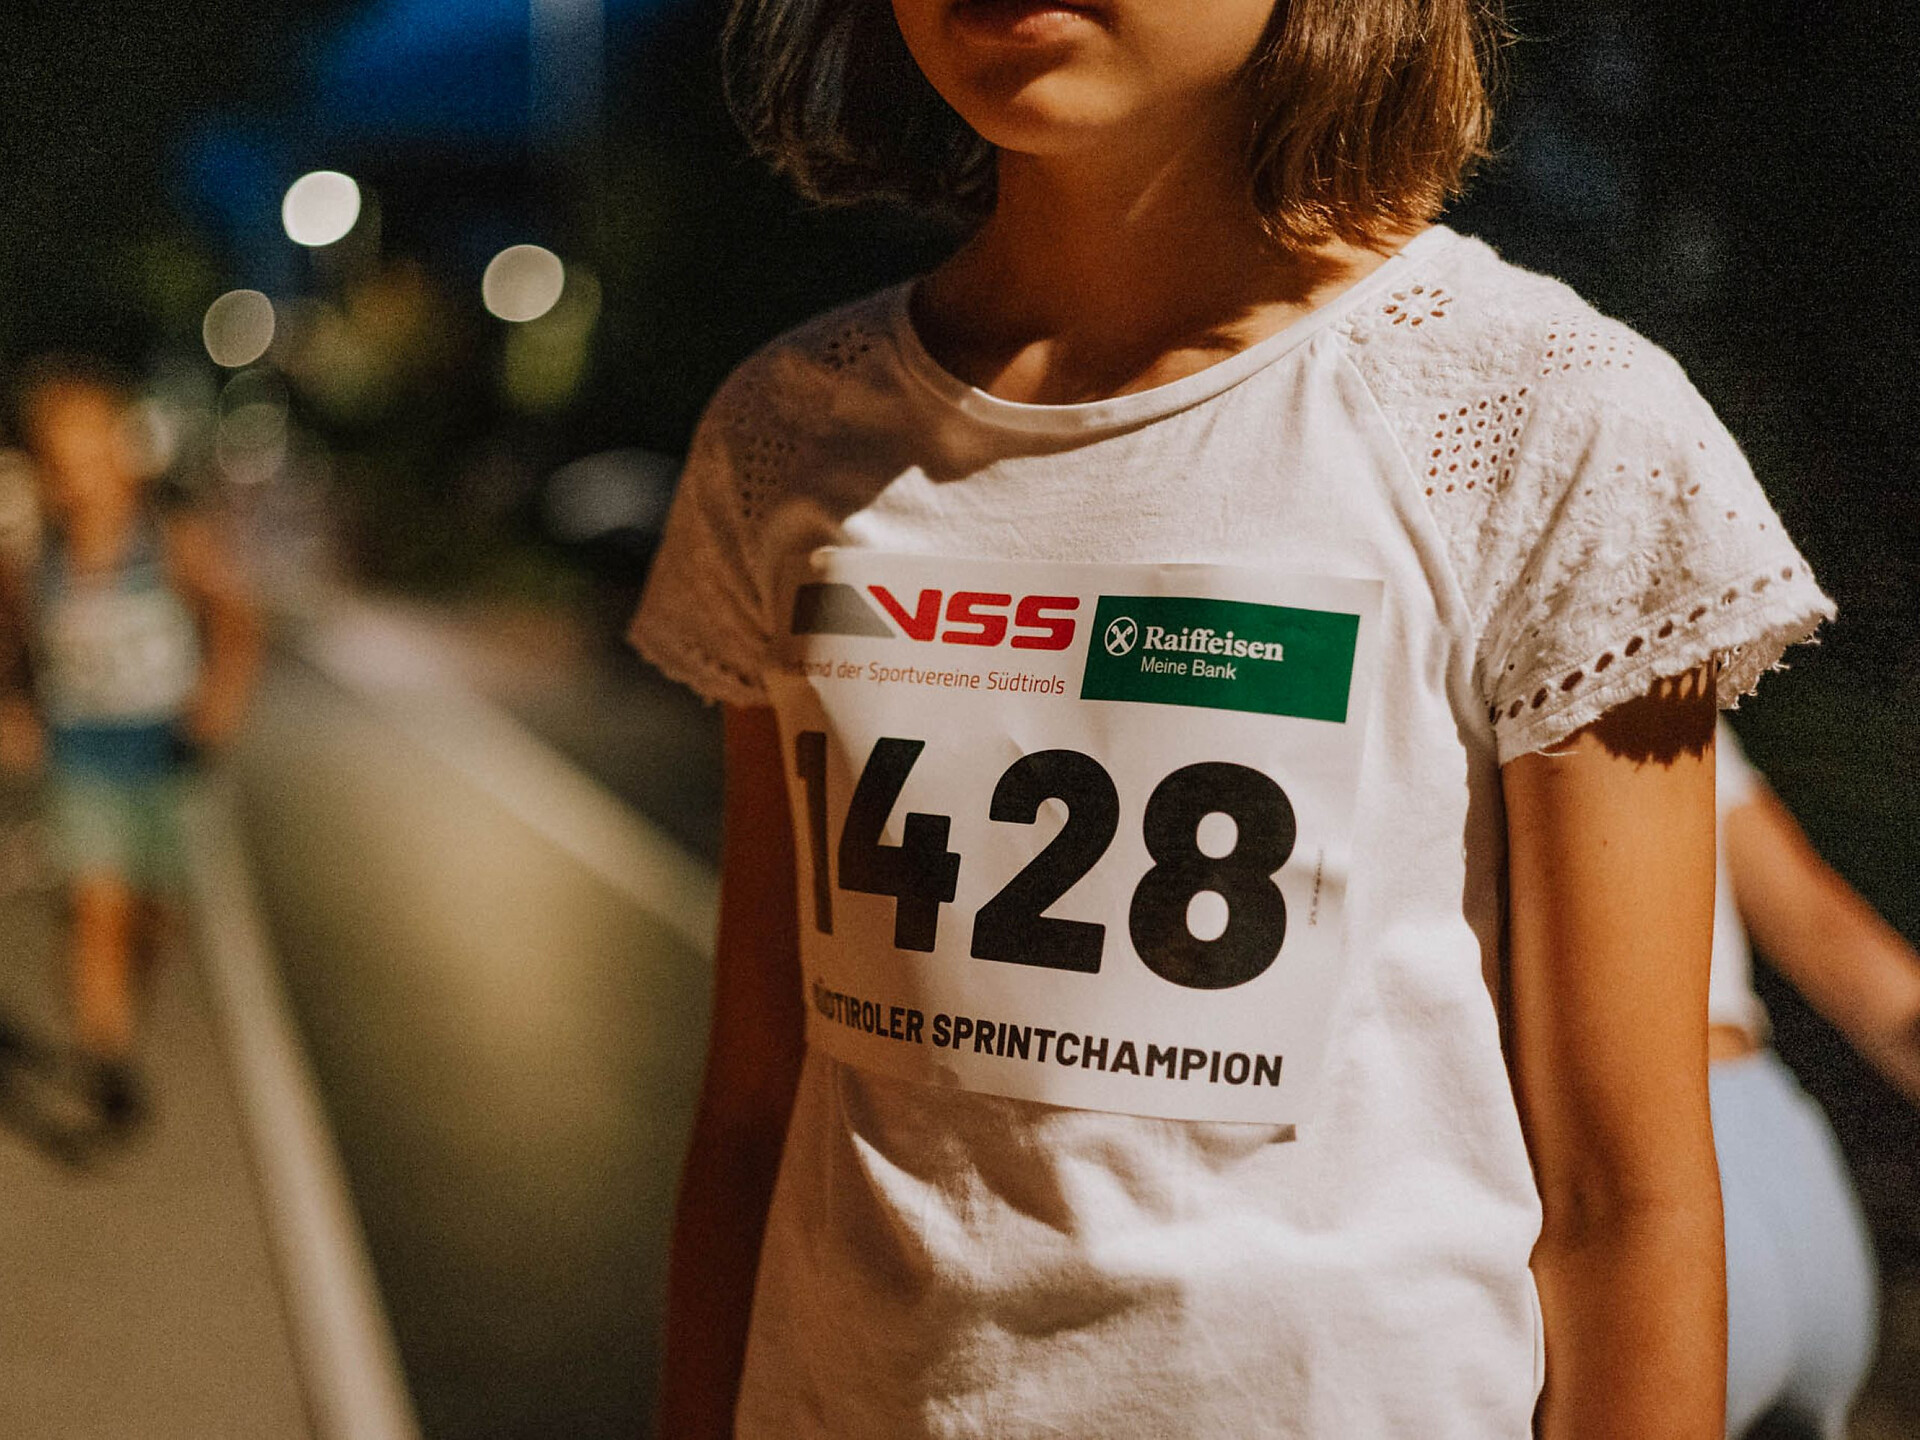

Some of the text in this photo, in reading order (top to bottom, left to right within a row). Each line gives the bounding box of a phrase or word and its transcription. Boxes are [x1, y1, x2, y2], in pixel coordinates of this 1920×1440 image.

[866, 584, 1080, 651] VSS
[1142, 625, 1284, 662] Raiffeisen
[837, 660, 863, 679] der
[869, 662, 980, 689] Sportvereine
[987, 671, 1065, 695] Südtirols
[1140, 656, 1237, 680] Meine Bank
[795, 729, 1297, 990] 1428
[931, 1013, 1284, 1087] SPRINTCHAMPION
